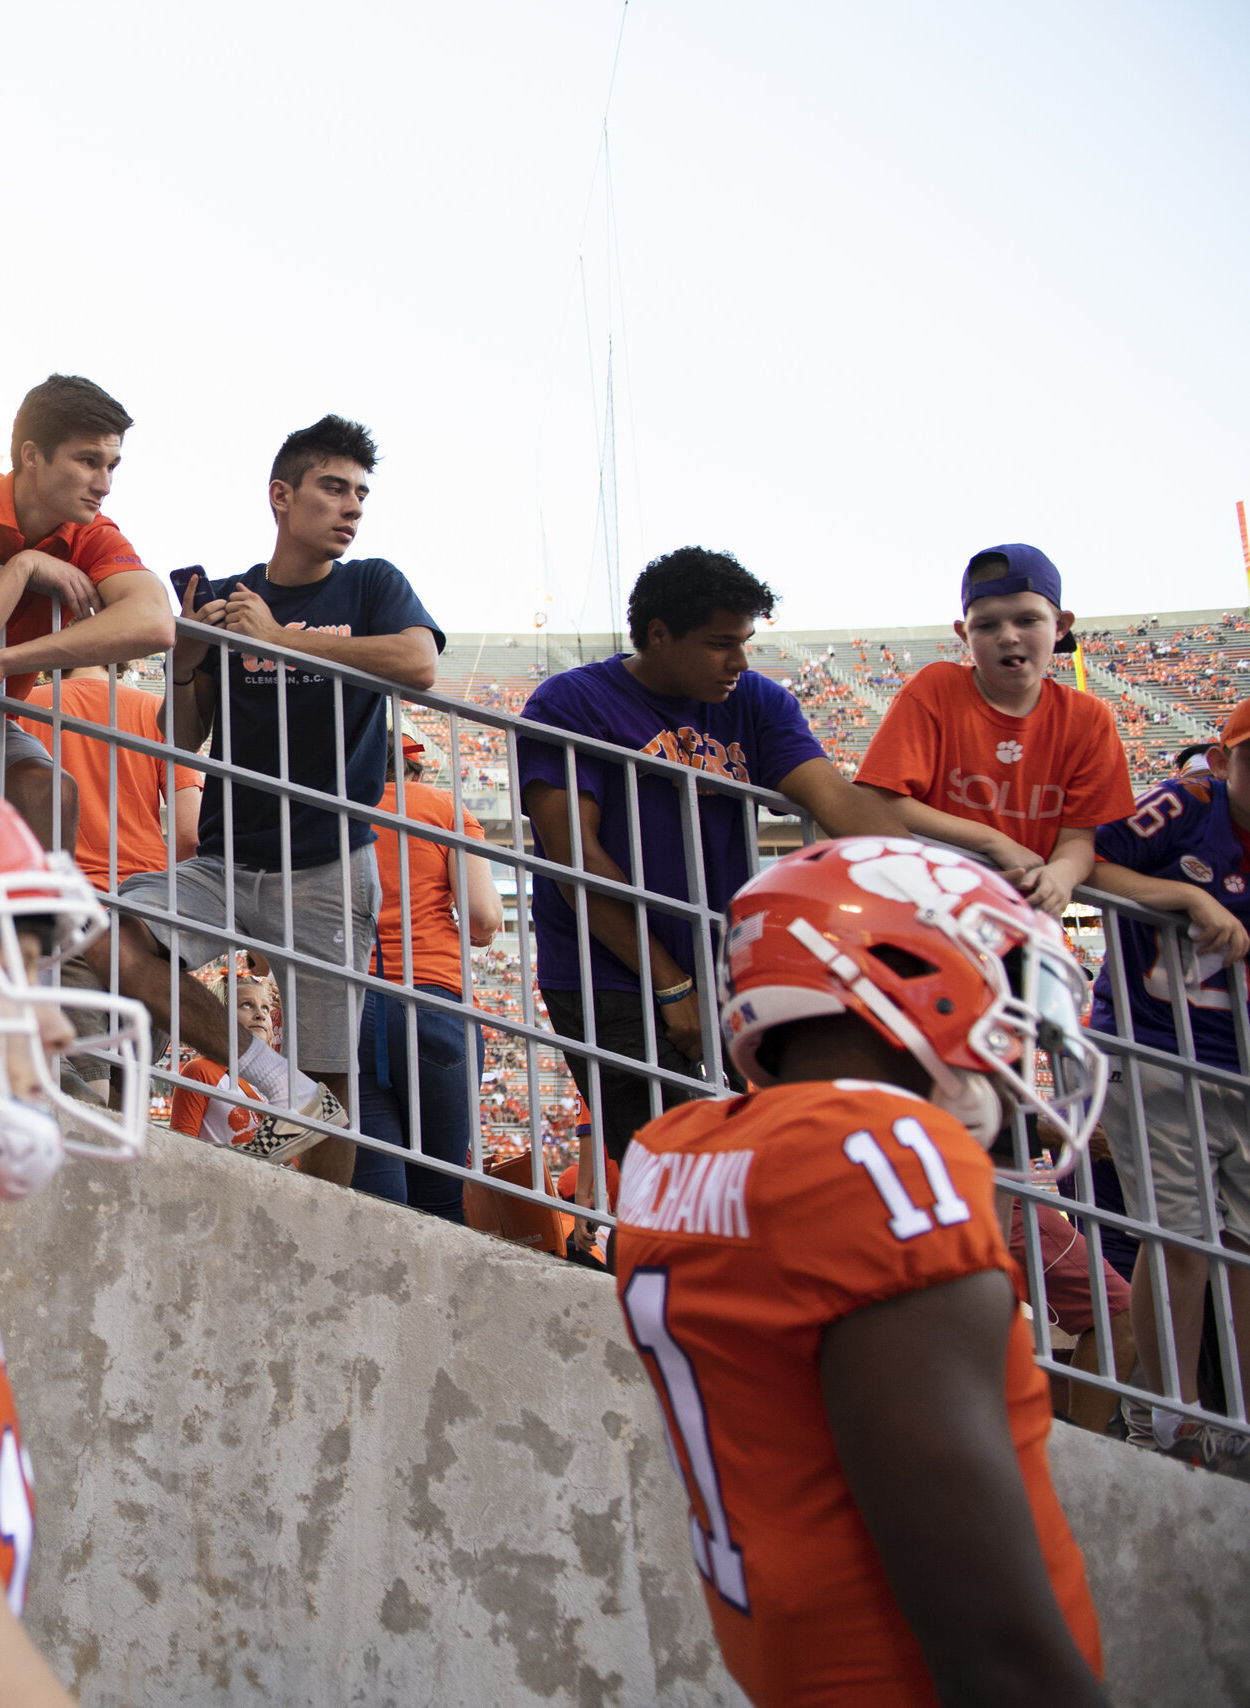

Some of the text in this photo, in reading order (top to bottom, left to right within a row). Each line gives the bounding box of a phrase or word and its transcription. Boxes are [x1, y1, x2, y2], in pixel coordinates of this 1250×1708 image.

[244, 674, 324, 685] CLEMSN, S.C.
[947, 767, 1065, 820] SOLID
[1182, 860, 1212, 880] ACC
[843, 1115, 971, 1242] 11
[623, 1266, 752, 1618] 1
